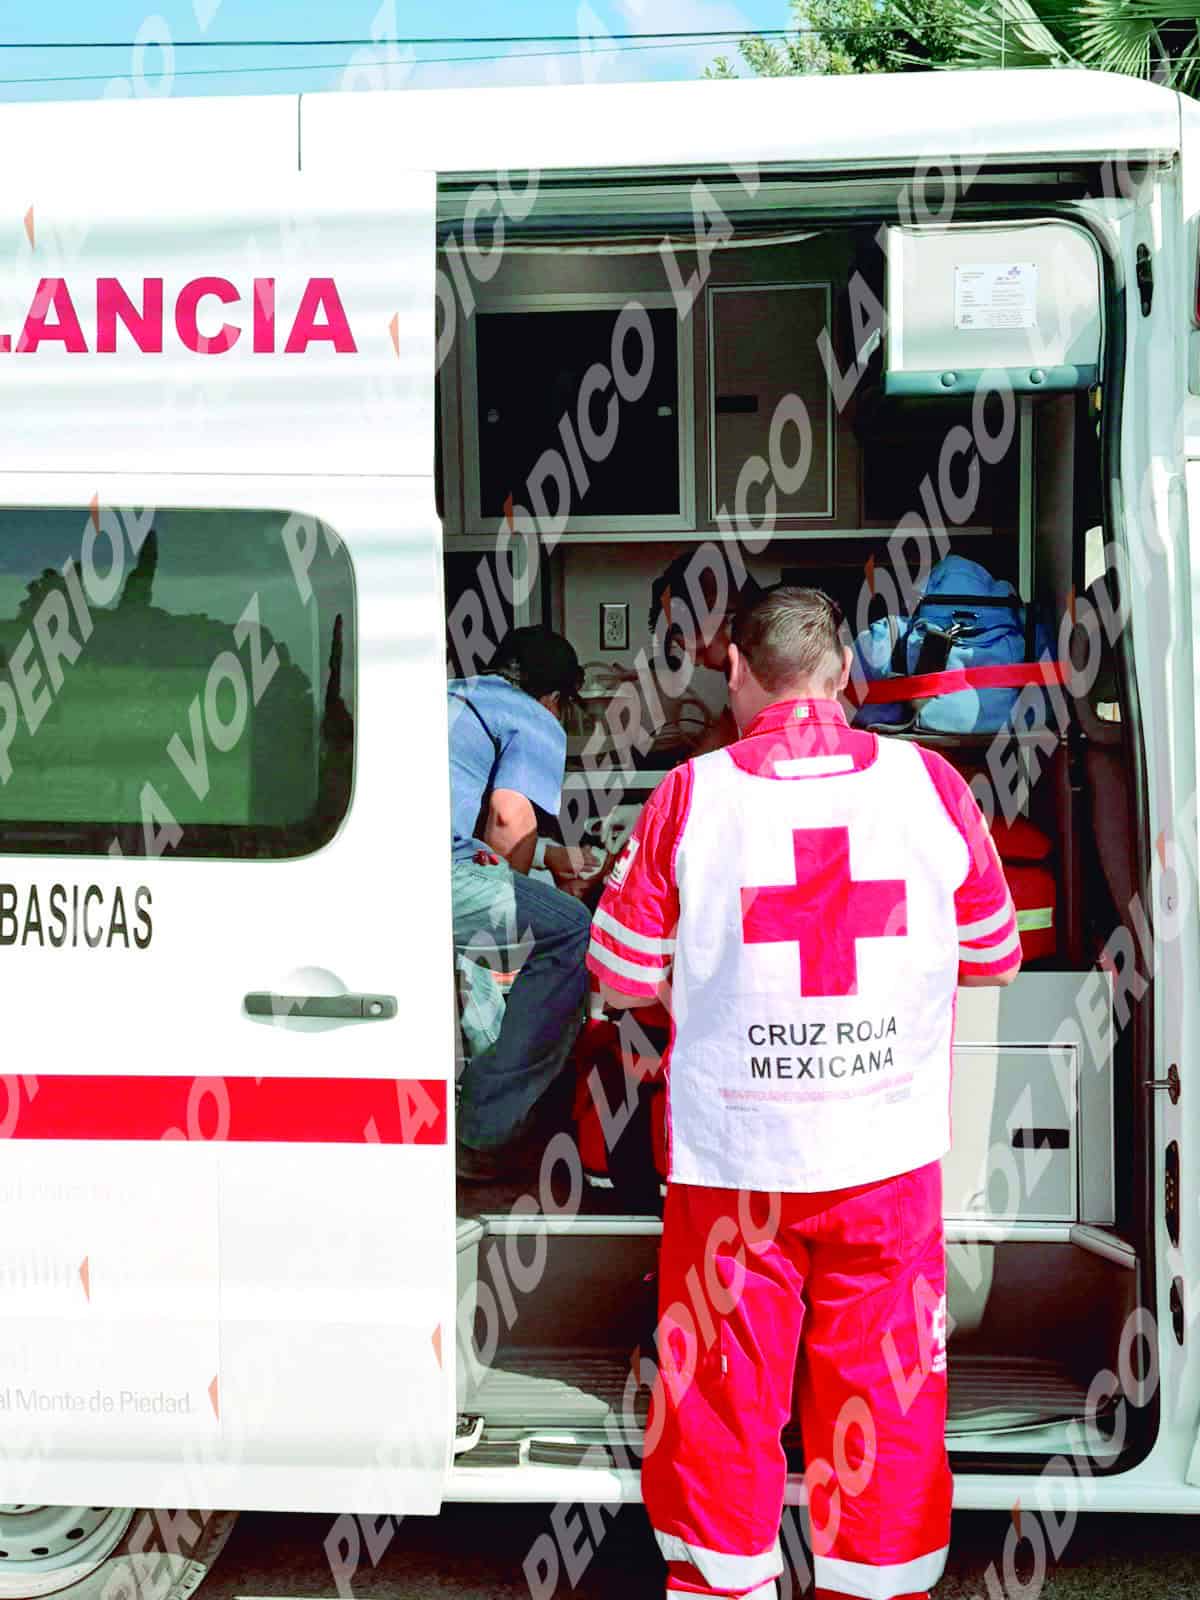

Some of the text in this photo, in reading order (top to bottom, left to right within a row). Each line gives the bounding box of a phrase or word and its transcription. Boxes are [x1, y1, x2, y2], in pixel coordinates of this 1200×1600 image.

[0, 277, 358, 354] ANCIA
[0, 884, 152, 949] BASICAS
[748, 1016, 897, 1046] CRUZ ROJA
[751, 1047, 894, 1079] MEXICANA
